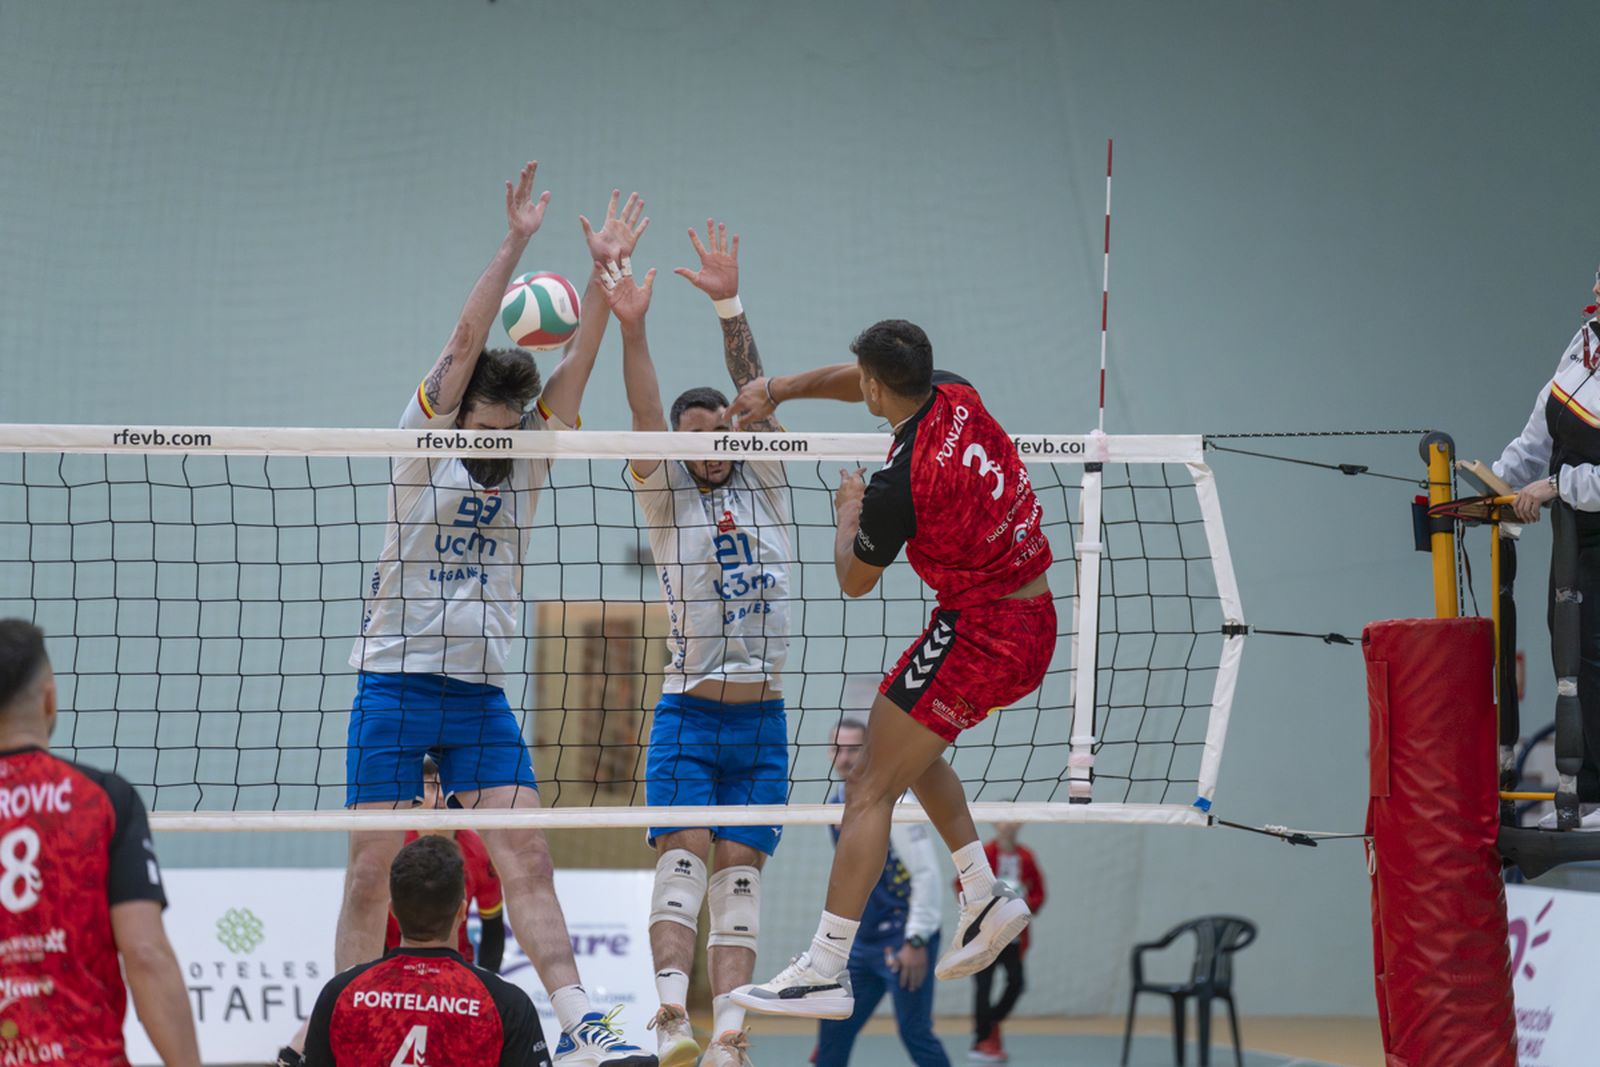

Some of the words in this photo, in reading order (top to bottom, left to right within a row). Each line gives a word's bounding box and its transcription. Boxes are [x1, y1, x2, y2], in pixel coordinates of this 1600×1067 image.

[113, 428, 212, 447] rfevb.com
[416, 432, 513, 450] rfevb.com
[713, 435, 808, 452] rfevb.com
[936, 405, 969, 467] PONZIO
[1014, 437, 1085, 454] fevb.co
[962, 442, 1005, 500] 3
[713, 532, 753, 571] 21
[0, 826, 42, 913] 8
[190, 961, 319, 979] OTELES
[353, 990, 480, 1017] PORTELANCE
[389, 1025, 428, 1067] 4
